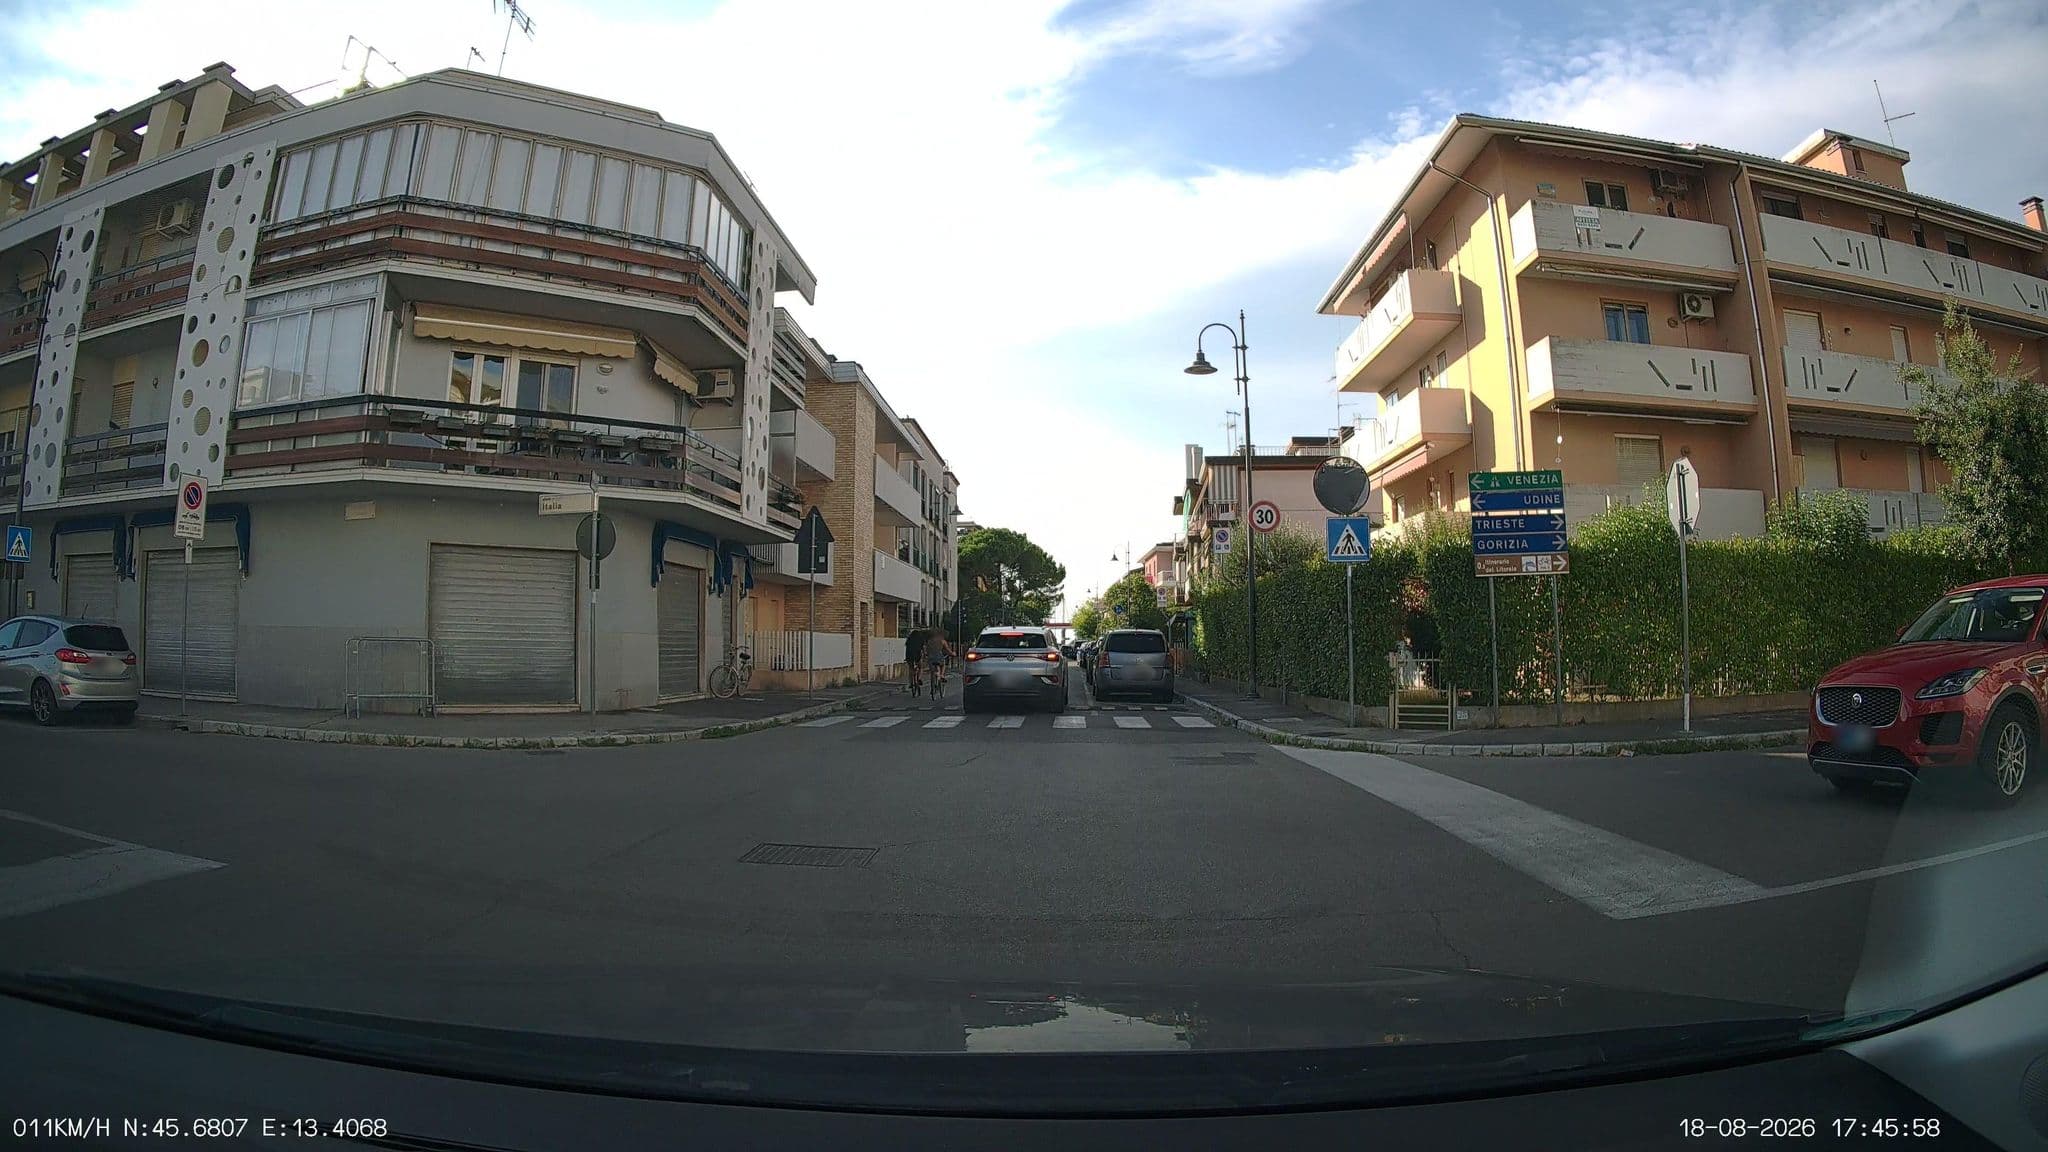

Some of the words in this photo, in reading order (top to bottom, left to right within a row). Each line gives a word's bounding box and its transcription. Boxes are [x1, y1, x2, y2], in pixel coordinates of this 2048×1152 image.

[1507, 474, 1559, 486] VENEZIA
[1523, 494, 1561, 506] UDINE
[543, 502, 562, 511] Italia
[1255, 509, 1274, 524] 30
[1475, 518, 1525, 530] TRIESTE
[1477, 538, 1529, 550] GORIZIA
